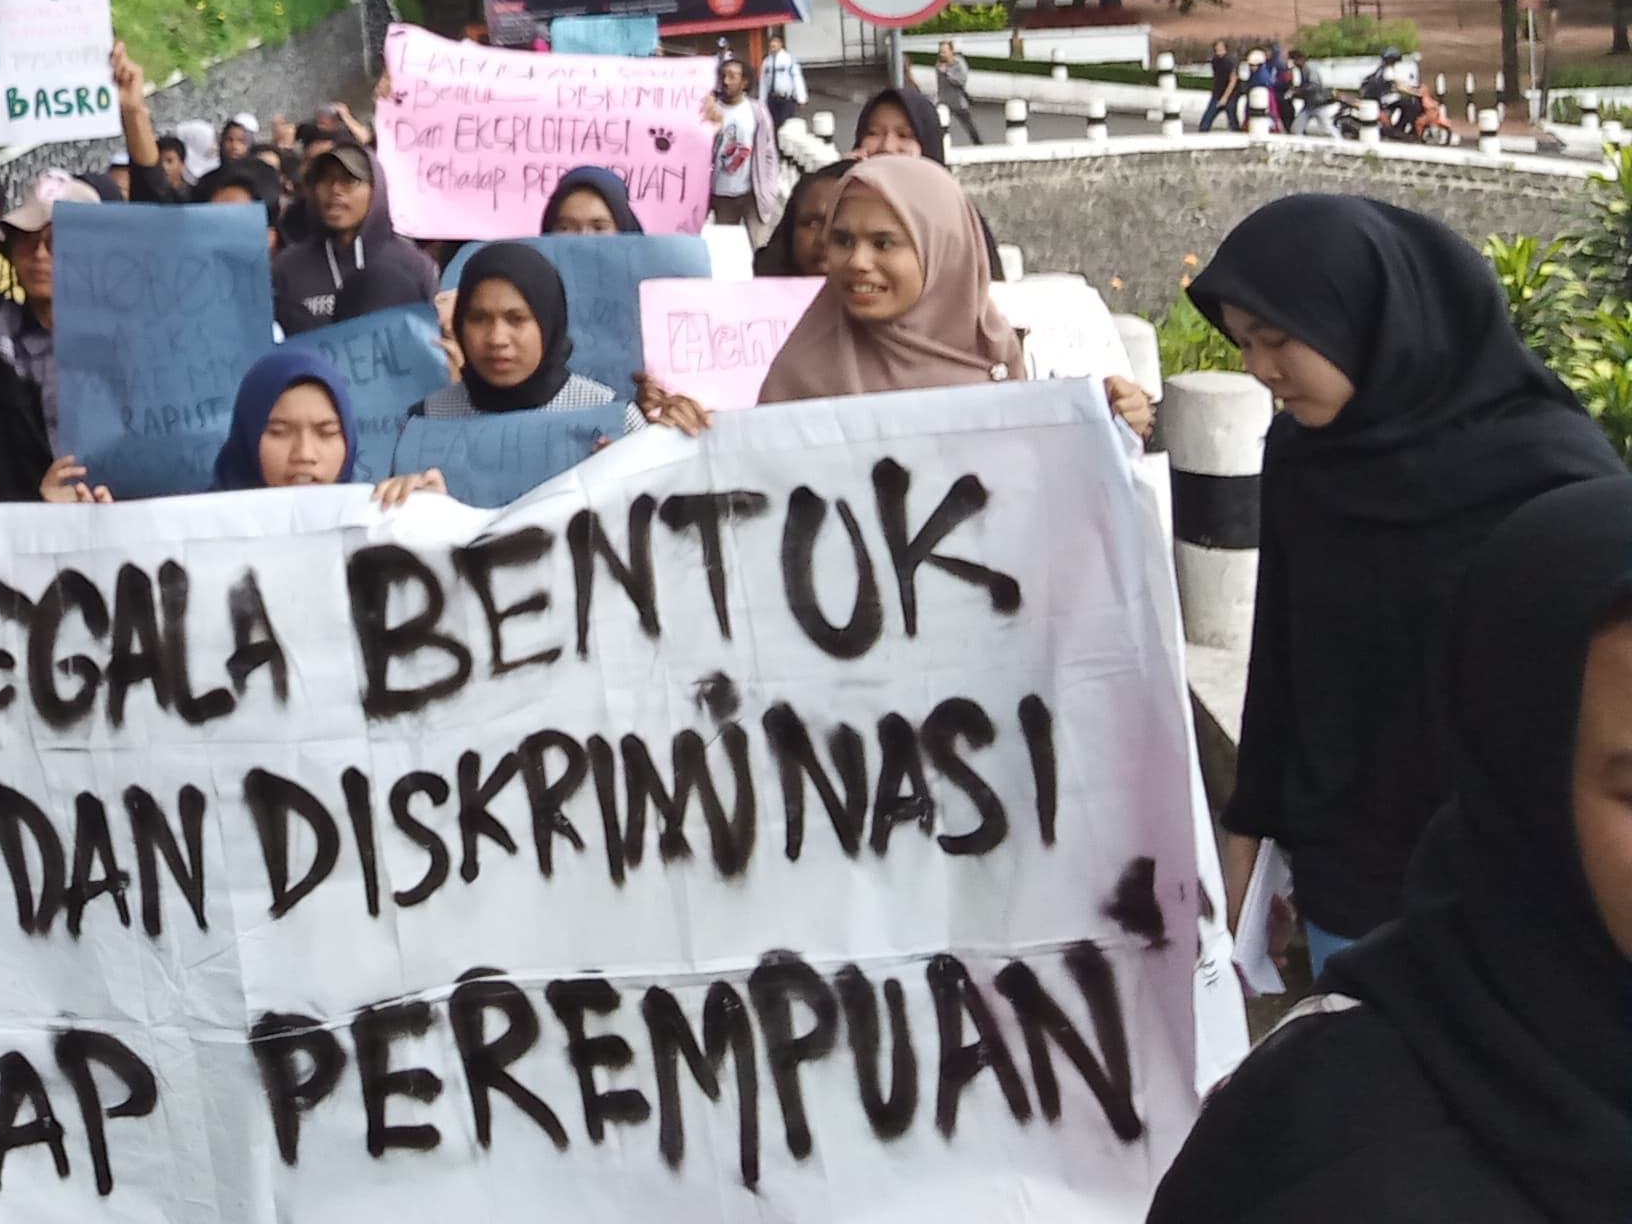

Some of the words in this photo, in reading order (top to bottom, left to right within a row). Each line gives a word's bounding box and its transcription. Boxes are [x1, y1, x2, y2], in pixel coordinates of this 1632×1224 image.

[4, 84, 112, 124] BASRO
[120, 396, 226, 438] RAPIST
[349, 456, 1023, 716] BENTUK
[249, 941, 1146, 1194] PEREMPUAN
